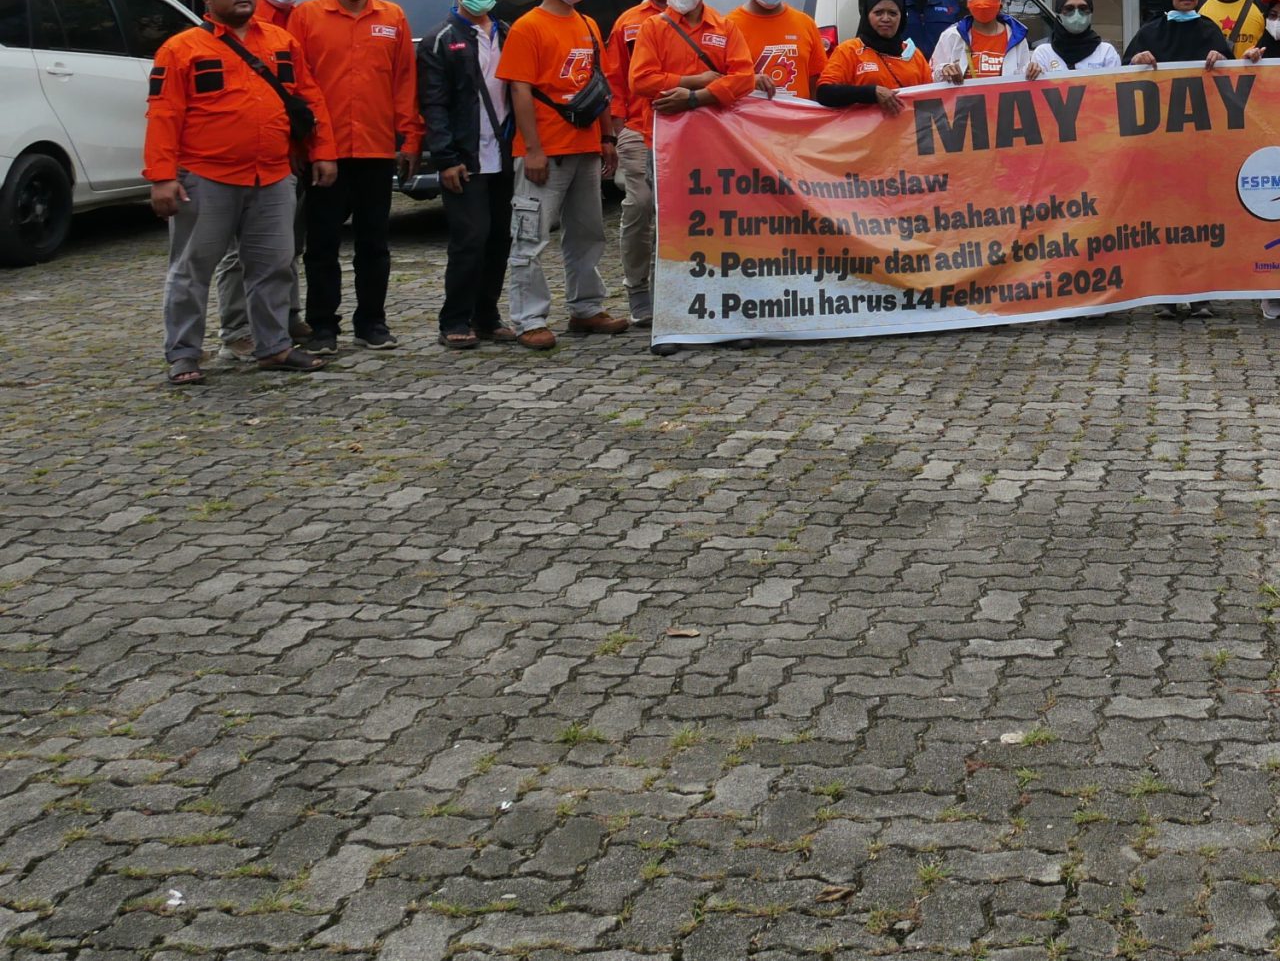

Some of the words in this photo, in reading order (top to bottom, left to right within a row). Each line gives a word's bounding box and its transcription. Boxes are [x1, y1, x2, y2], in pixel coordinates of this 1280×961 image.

[981, 54, 1003, 64] Part
[981, 63, 1002, 71] Bur
[913, 85, 1087, 156] MAY
[1115, 74, 1257, 137] DAY
[688, 168, 713, 195] 1.
[718, 168, 795, 196] Tolak
[798, 169, 949, 199] omnibuslaw
[688, 210, 714, 237] 2.
[720, 209, 851, 237] Turunkan
[852, 212, 931, 241] harga
[934, 203, 1016, 233] bahan
[1020, 191, 1099, 230] pokok
[689, 251, 715, 278] 3.
[721, 247, 812, 278] Pemilu
[814, 247, 881, 283] jujur
[885, 248, 931, 275] dan
[935, 241, 983, 272] adil
[987, 239, 1007, 267] &
[1011, 232, 1079, 264] tolak
[1087, 221, 1161, 261] politik
[1166, 222, 1226, 248] uang
[688, 293, 716, 320] 4.
[722, 289, 814, 319] Pemilu
[819, 289, 898, 315] harus
[901, 287, 934, 311] 14
[939, 271, 1052, 308] Februari
[1056, 265, 1124, 297] 2024
